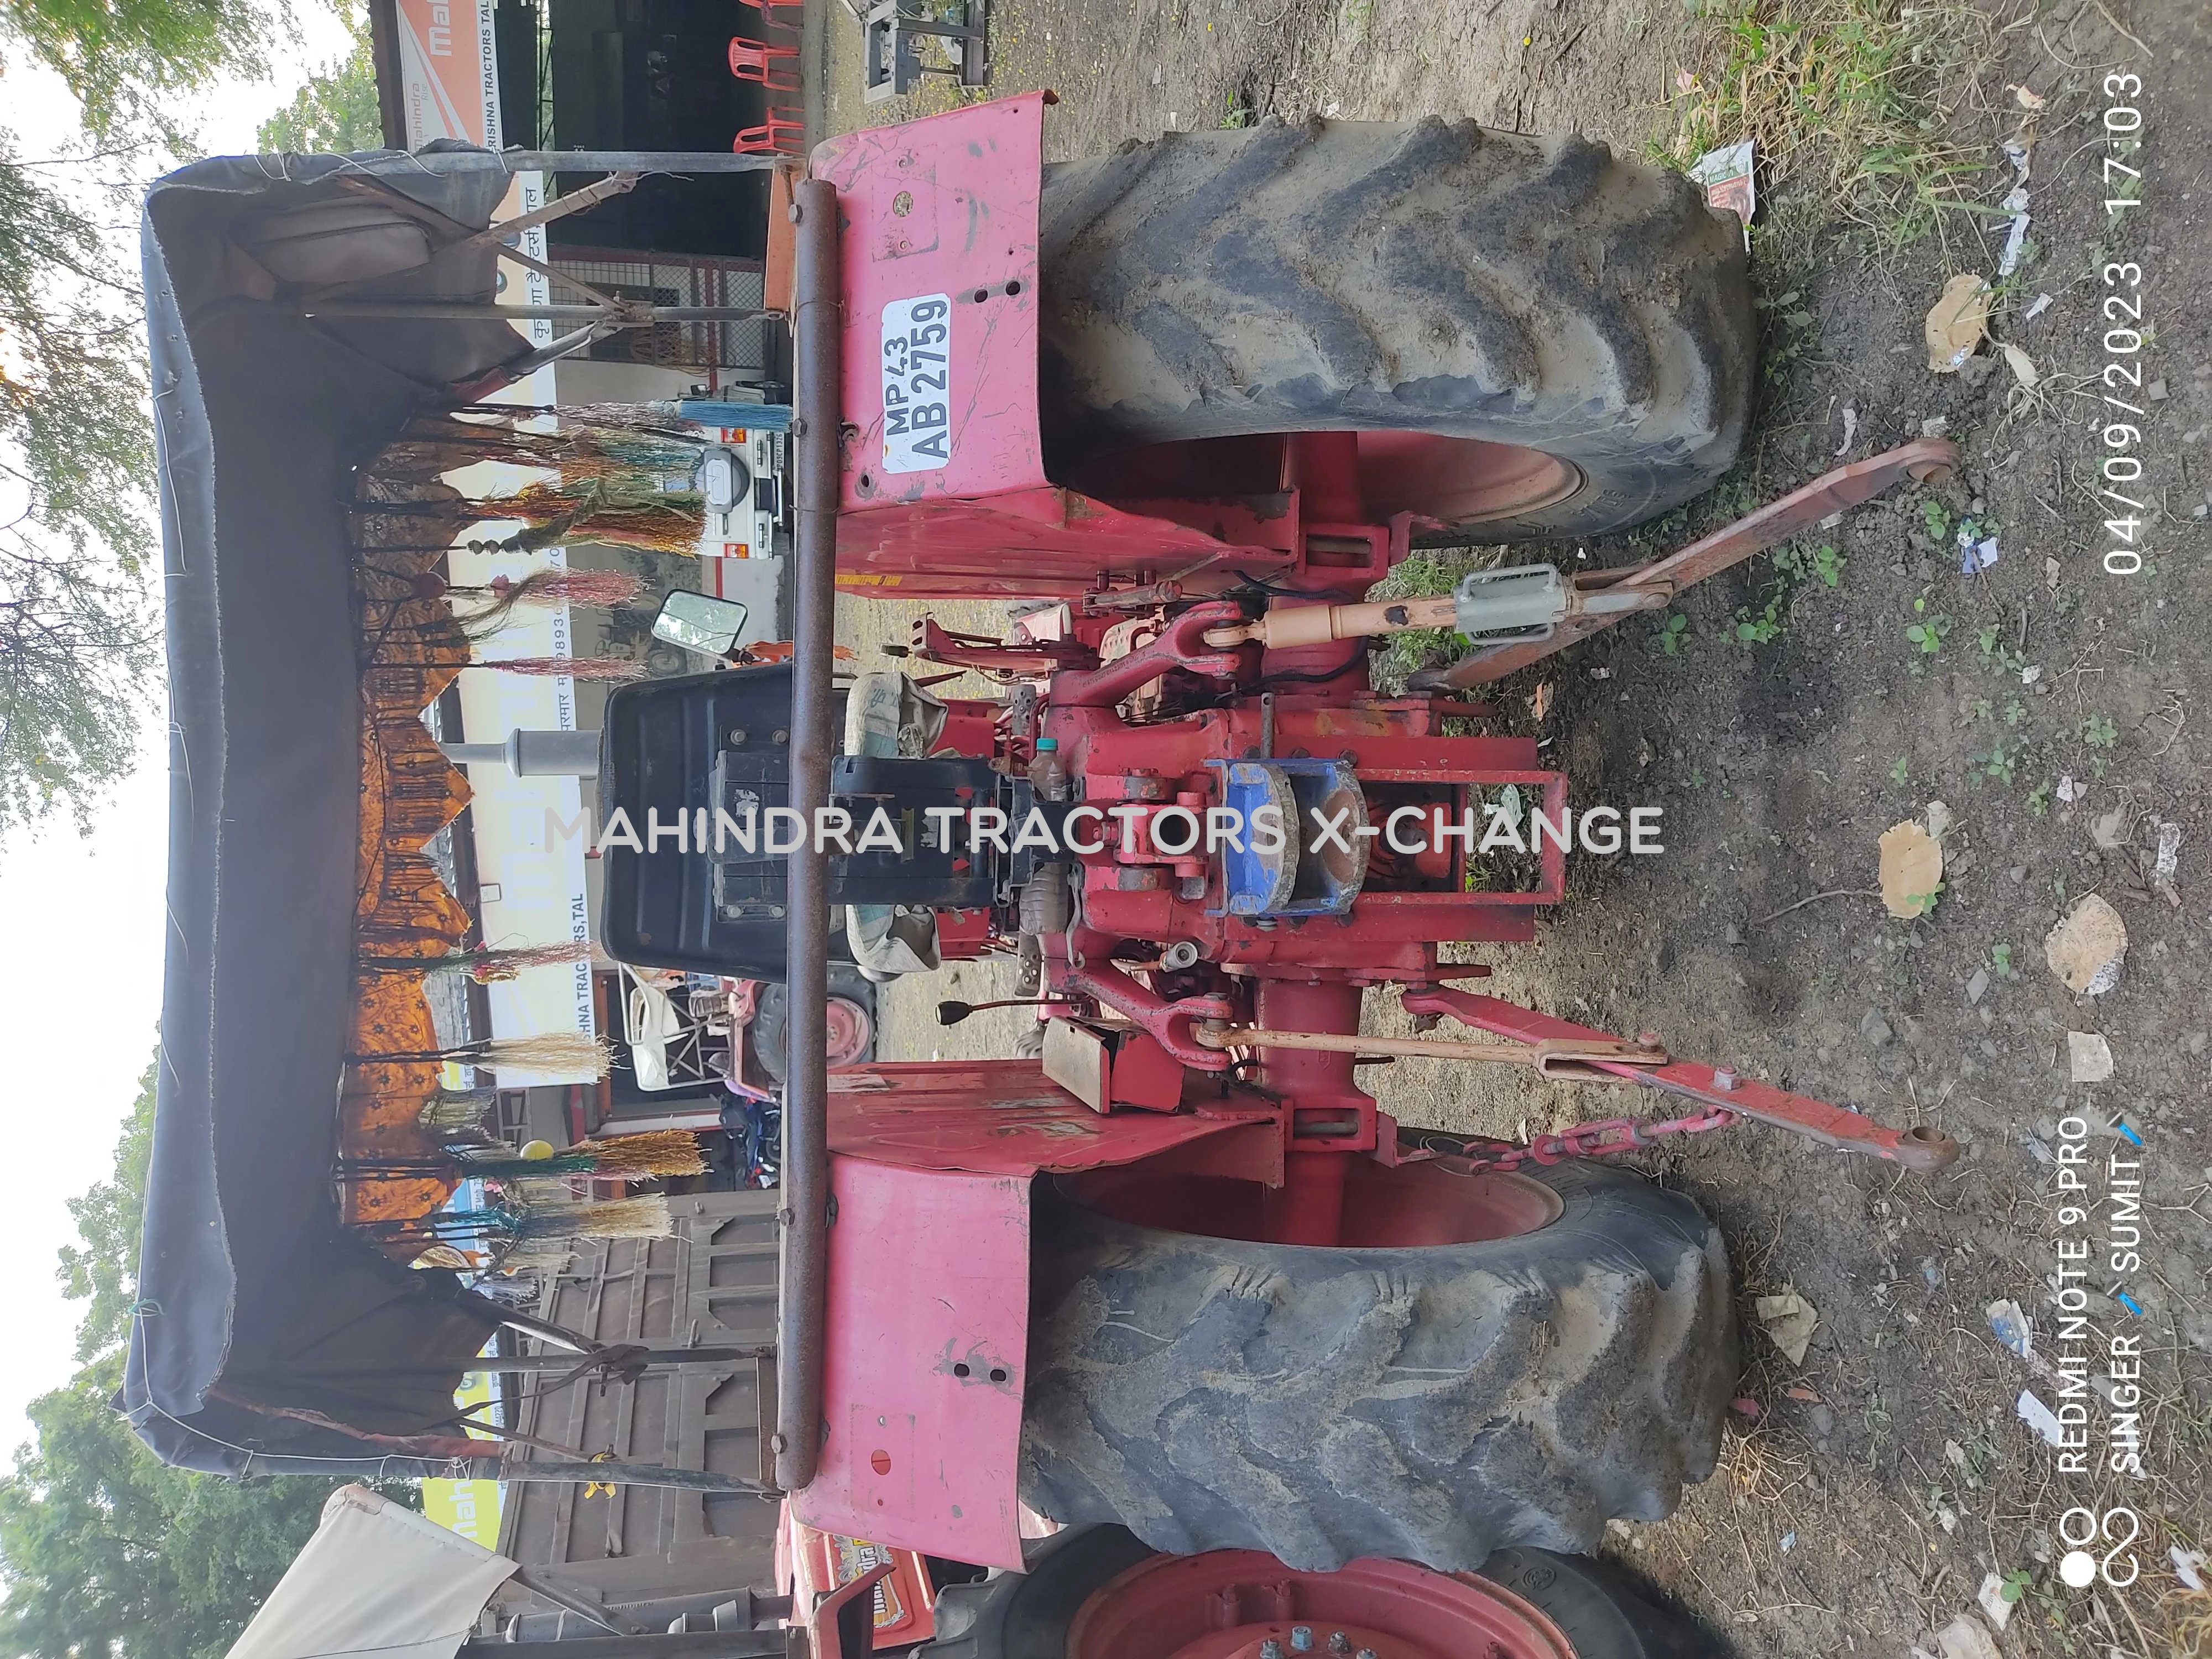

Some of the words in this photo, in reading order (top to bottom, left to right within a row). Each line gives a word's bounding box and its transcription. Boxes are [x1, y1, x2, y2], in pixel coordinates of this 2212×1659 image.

[480, 1, 490, 24] TAL
[481, 29, 494, 97] TRACTORS
[486, 101, 496, 147] RISHNA
[884, 336, 908, 377] 43
[910, 299, 947, 394] 2759
[885, 384, 909, 436] MP
[911, 402, 948, 459] AB
[571, 893, 588, 1000] TRACRS,TAL
